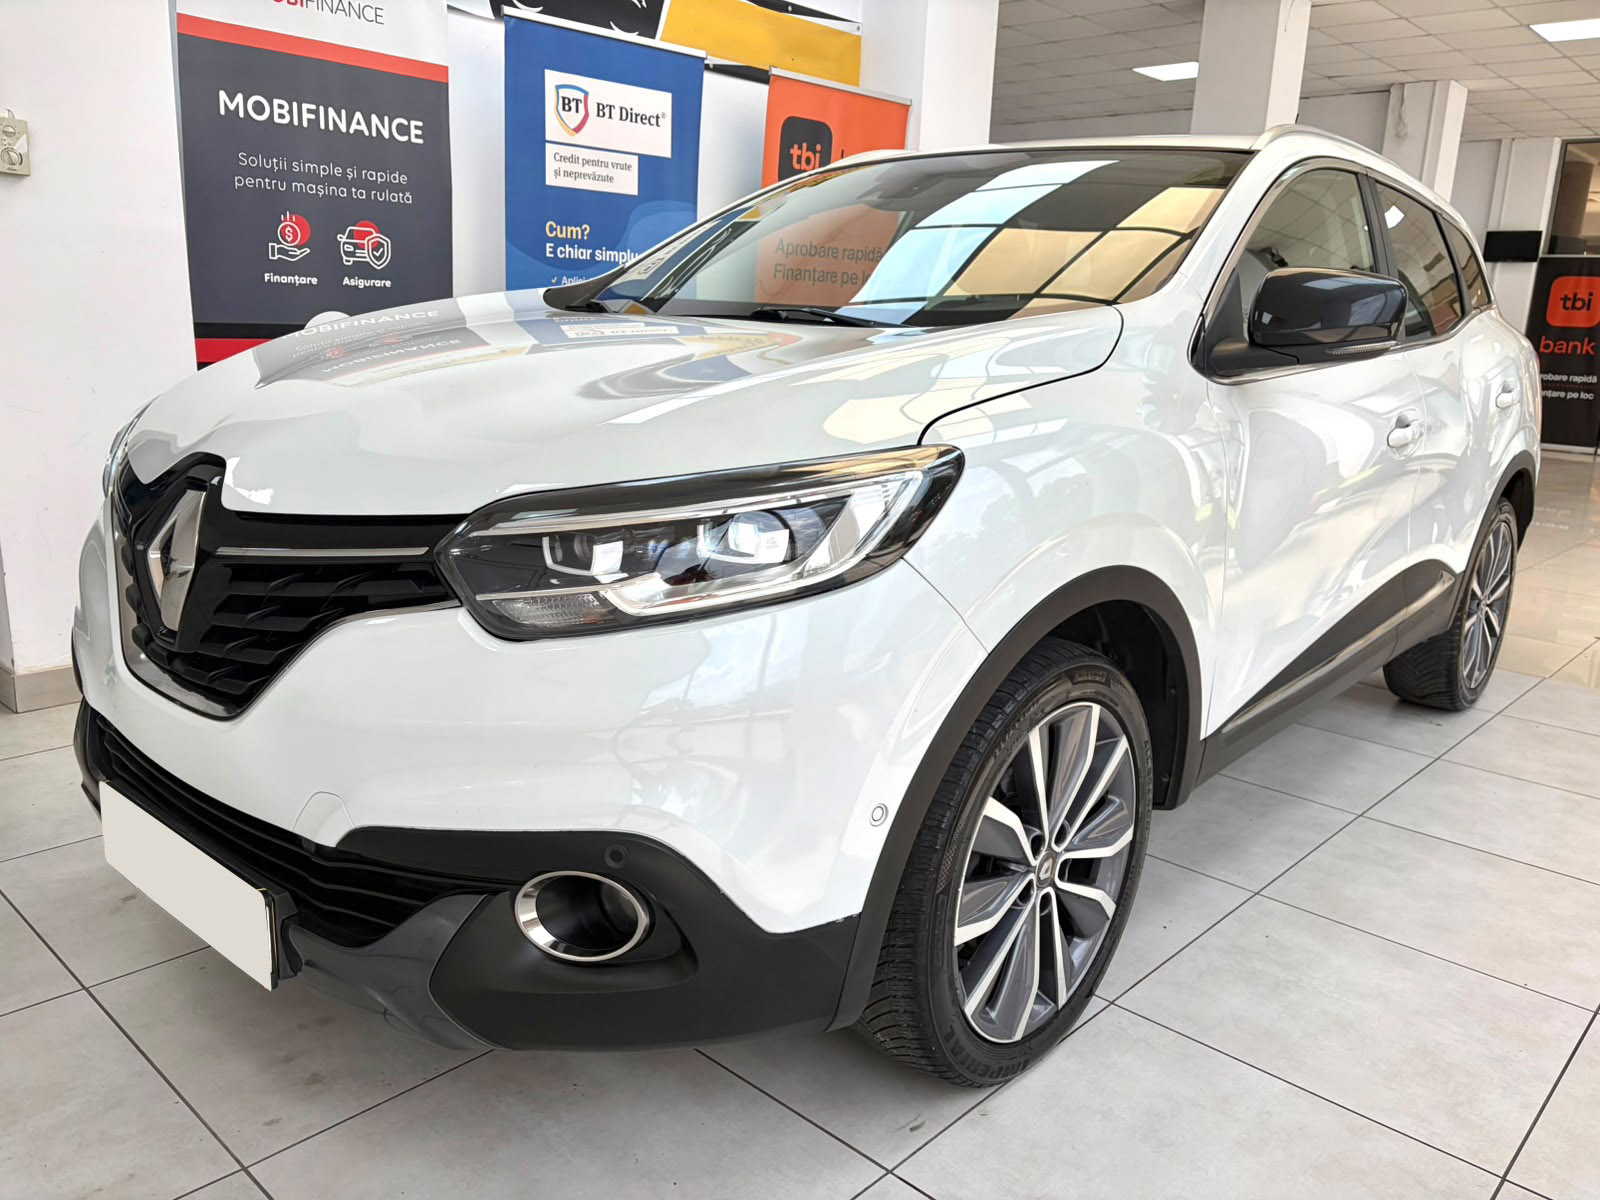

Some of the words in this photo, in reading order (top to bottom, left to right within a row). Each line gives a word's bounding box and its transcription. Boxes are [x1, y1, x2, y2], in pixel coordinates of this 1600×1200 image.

[561, 96, 583, 114] BT
[596, 102, 615, 120] BT
[218, 89, 424, 144] MOBIFINANCE
[553, 152, 580, 165] Credit
[582, 158, 609, 170] pentru
[611, 161, 632, 172] vrute
[790, 142, 821, 171] tbi
[238, 152, 287, 172] Soluții
[292, 160, 342, 177] simple
[346, 166, 357, 181] și
[362, 168, 408, 185] rapide
[554, 167, 561, 179] și
[563, 170, 614, 184] neprevăzute
[235, 175, 286, 192] pentru
[292, 182, 347, 198] mașina
[351, 187, 366, 200] ta
[371, 190, 412, 204] rulată
[545, 221, 591, 240] Cum?
[546, 243, 555, 258] E
[557, 244, 592, 261] chiar
[776, 238, 839, 259] Aprobare
[842, 245, 883, 264] rapidă
[264, 273, 318, 286] Finanțare
[343, 276, 391, 288] Asigurare
[774, 263, 837, 286] Finanțare
[840, 271, 858, 288] pe
[1560, 292, 1593, 311] tbi
[1540, 336, 1596, 356] bank
[1540, 373, 1568, 381] robare
[1566, 391, 1579, 400] pe
[1580, 391, 1594, 400] loc
